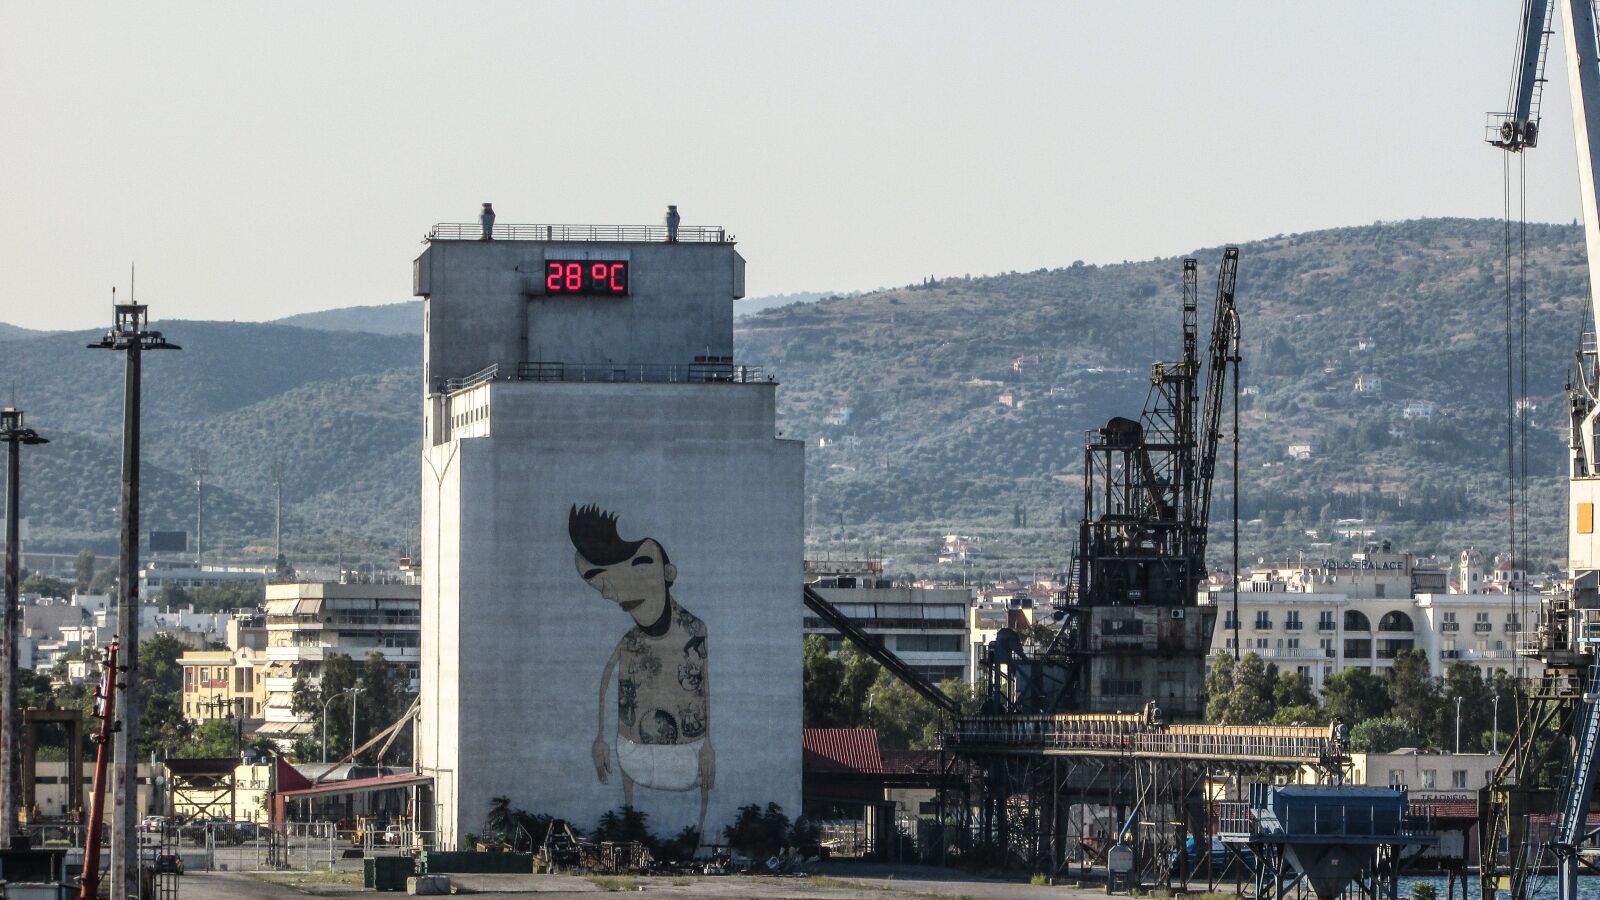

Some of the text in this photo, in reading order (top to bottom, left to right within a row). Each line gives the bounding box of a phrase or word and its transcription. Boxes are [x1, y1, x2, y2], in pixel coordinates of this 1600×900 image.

[547, 262, 582, 290] 28
[1321, 558, 1404, 570] VOLOS PALACE
